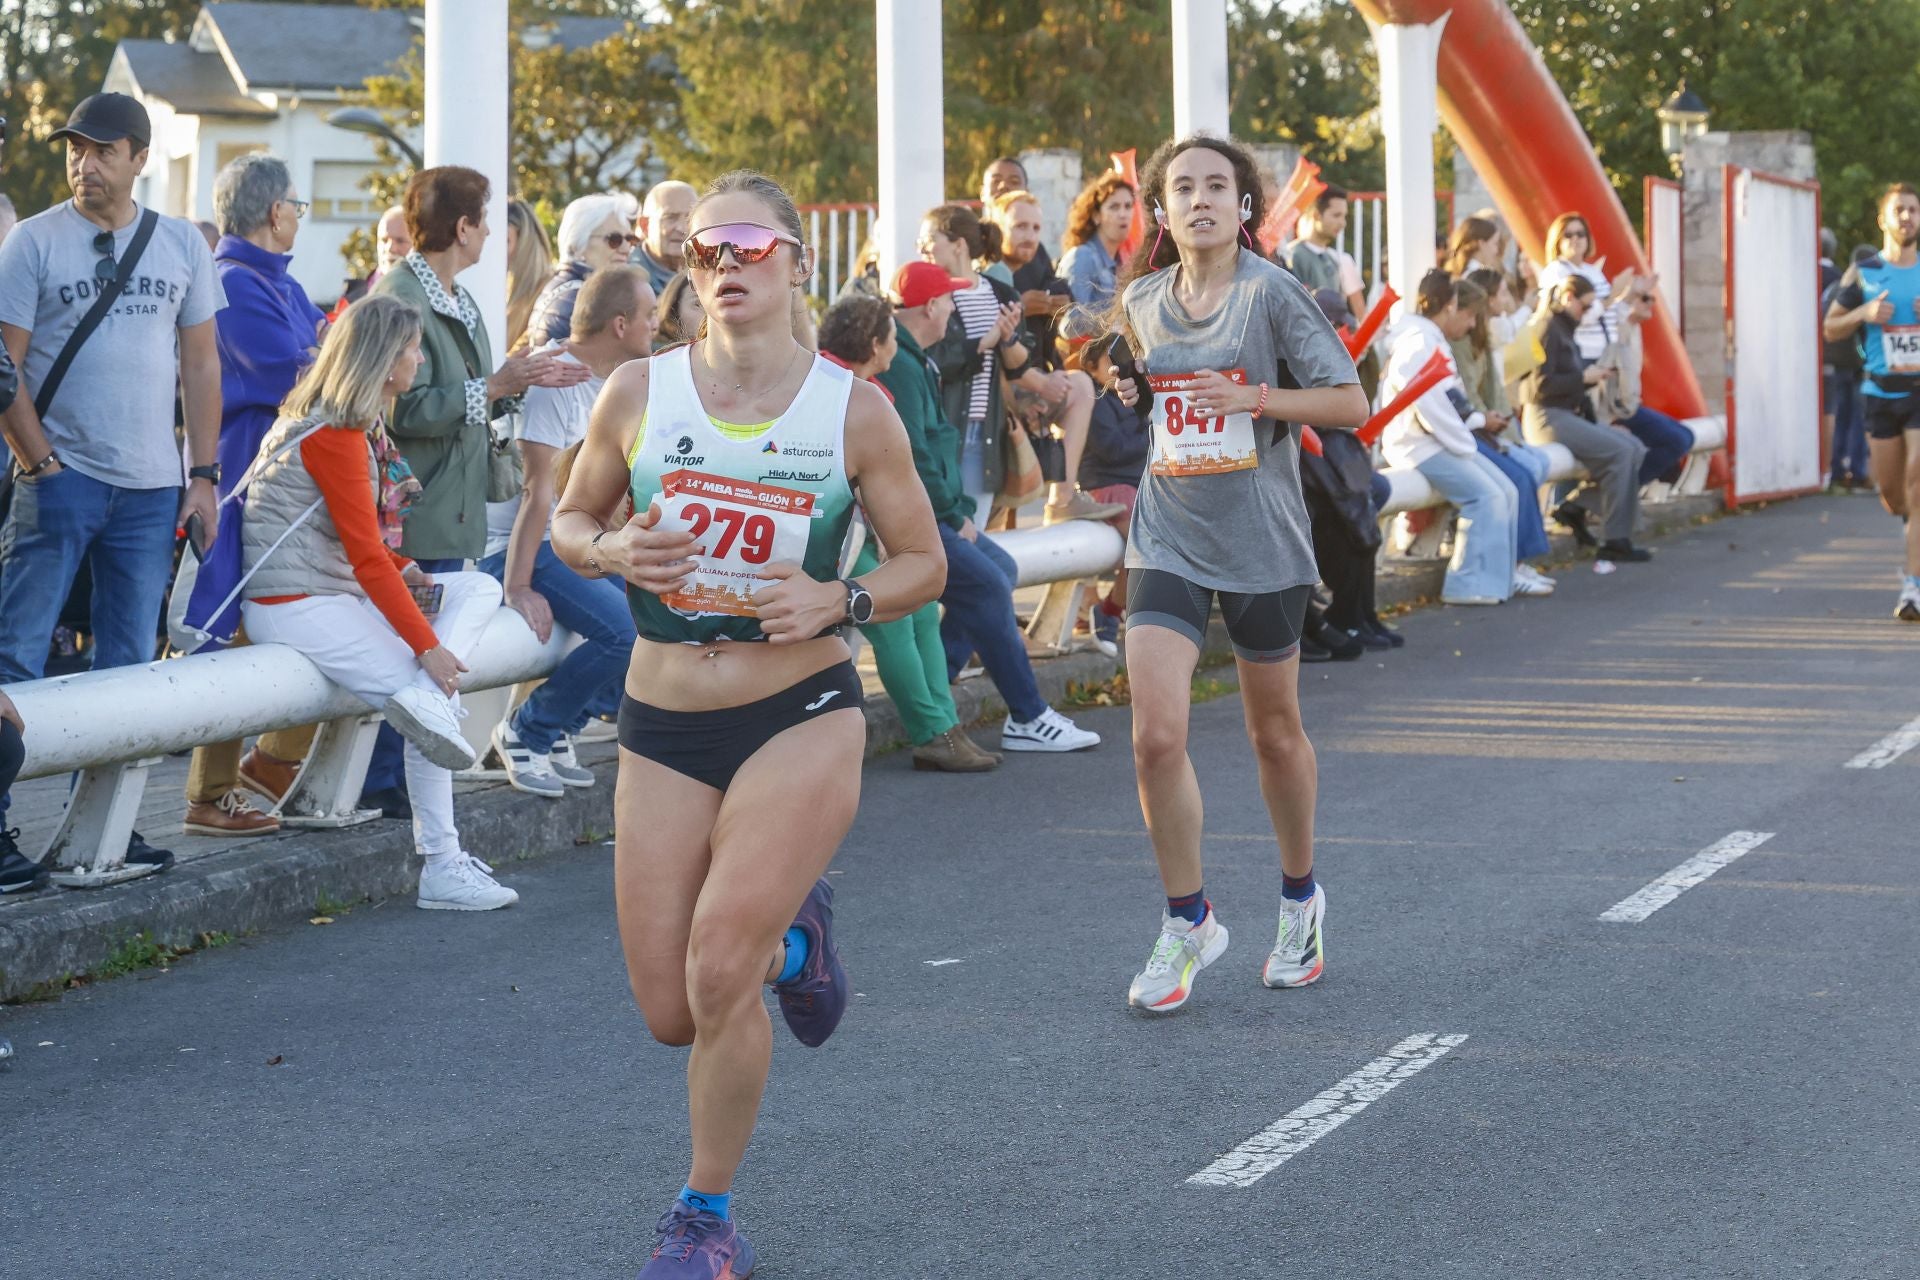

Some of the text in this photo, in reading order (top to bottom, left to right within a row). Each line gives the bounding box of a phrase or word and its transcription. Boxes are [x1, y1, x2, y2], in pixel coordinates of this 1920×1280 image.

[59, 276, 179, 304] CONERSE
[126, 304, 158, 315] STAR
[1890, 335, 1920, 353] 145
[1175, 441, 1195, 449] LORENA
[664, 454, 705, 467] VIATOR
[702, 481, 733, 496] MBA
[758, 492, 790, 506] GIJÓN
[680, 502, 775, 565] 279
[697, 567, 760, 580] IULIANA POPES
